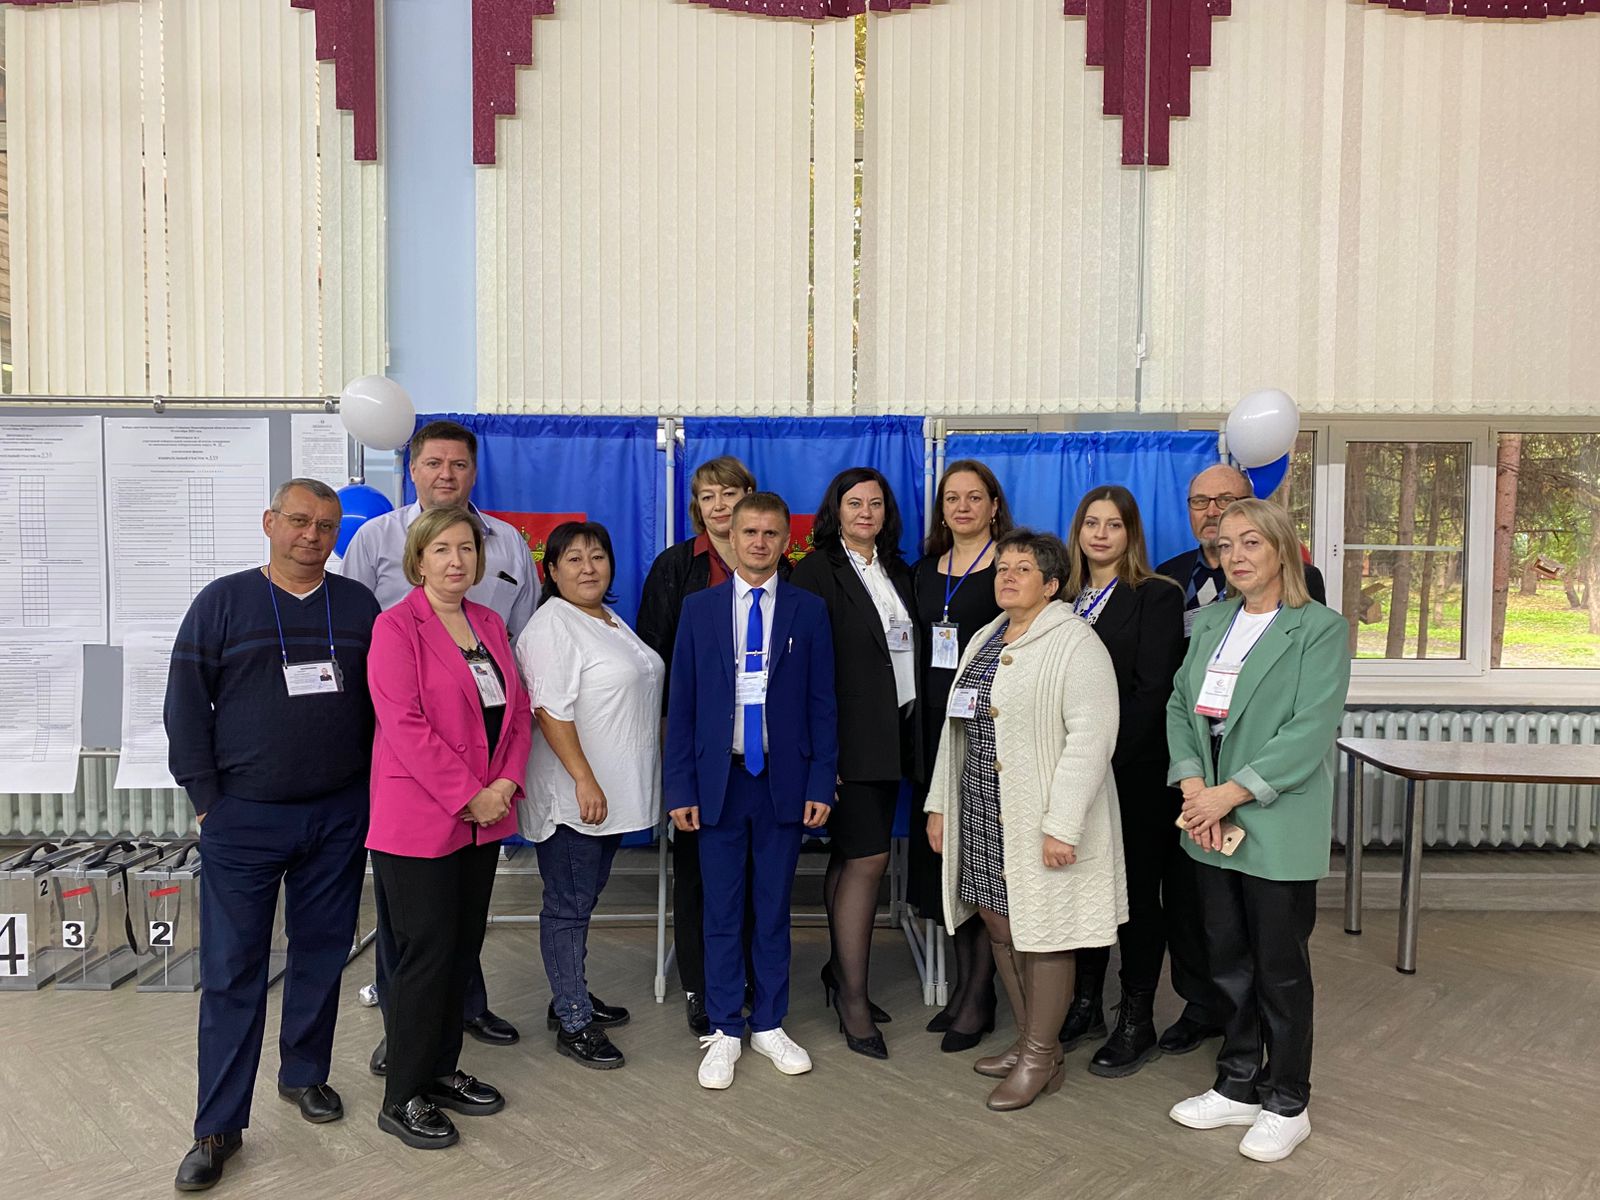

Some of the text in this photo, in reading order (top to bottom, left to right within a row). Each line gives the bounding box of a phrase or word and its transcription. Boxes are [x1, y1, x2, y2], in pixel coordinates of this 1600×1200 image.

[40, 879, 49, 897] 2
[64, 922, 83, 946] 3
[151, 921, 171, 945] 2
[0, 916, 25, 975] 4
